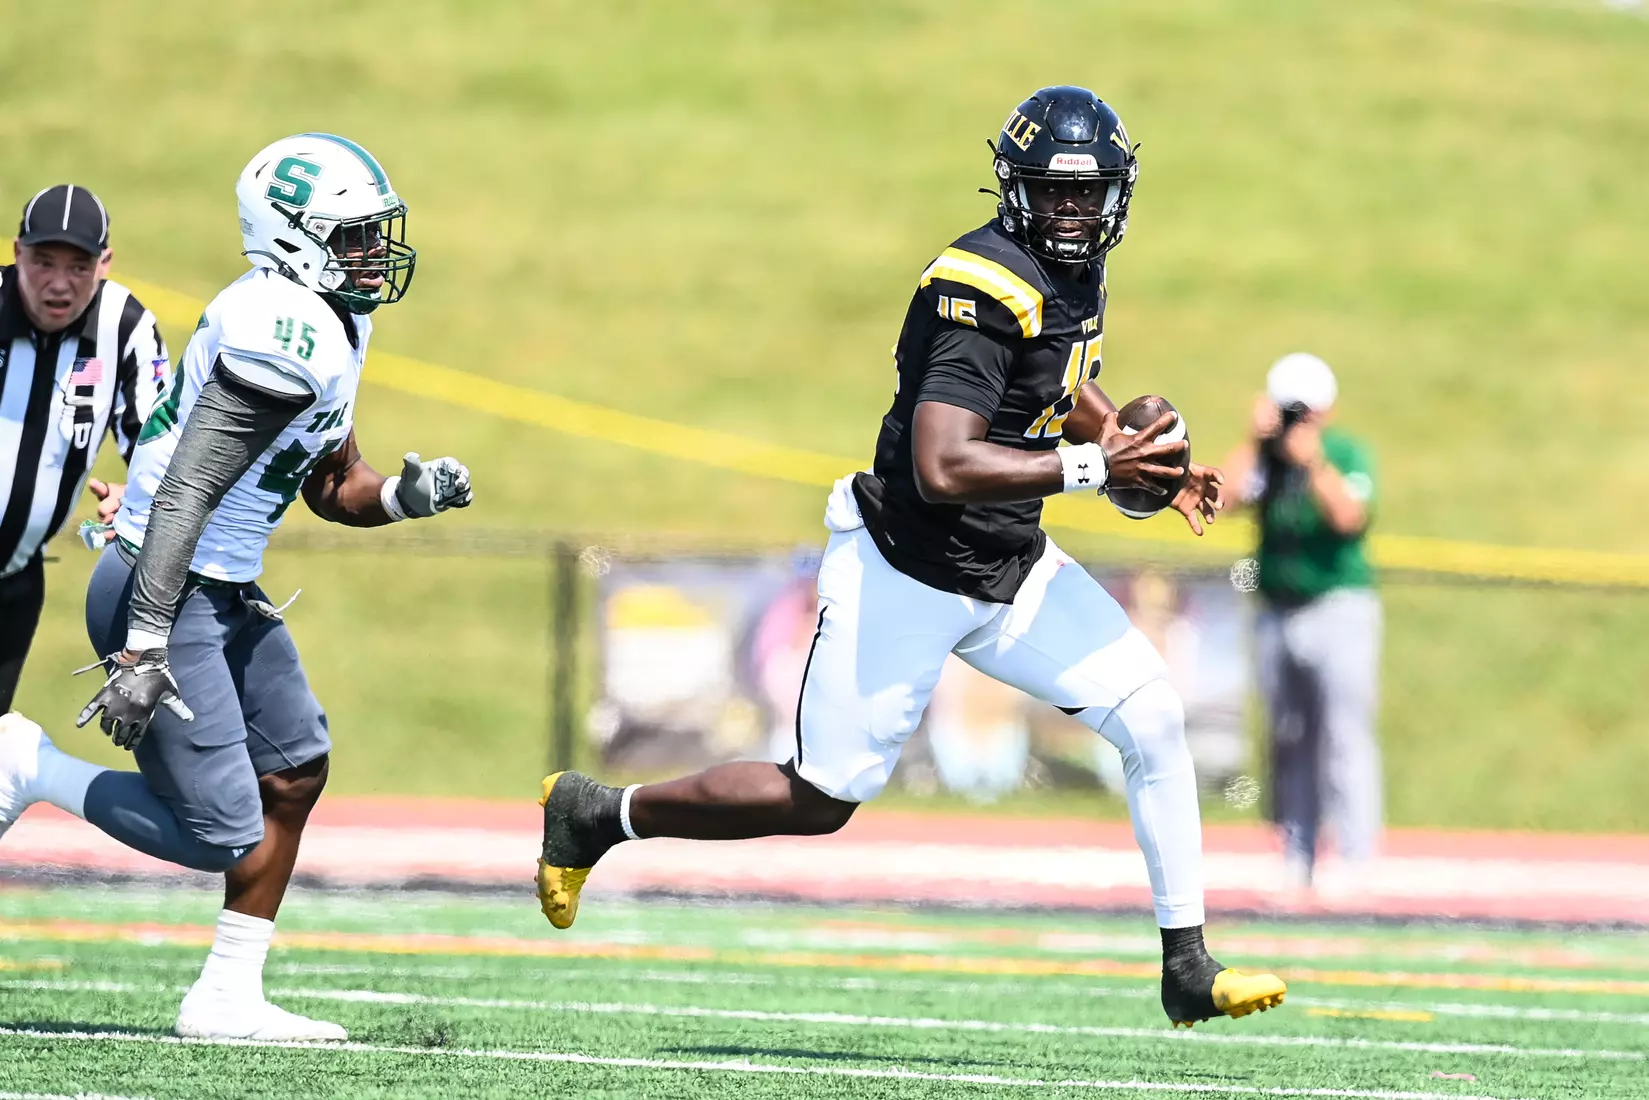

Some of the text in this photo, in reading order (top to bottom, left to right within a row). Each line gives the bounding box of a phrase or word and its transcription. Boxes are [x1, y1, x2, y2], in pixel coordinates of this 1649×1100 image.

[264, 154, 324, 209] S
[936, 294, 979, 328] 15
[273, 316, 318, 361] 45
[1023, 333, 1103, 438] 15
